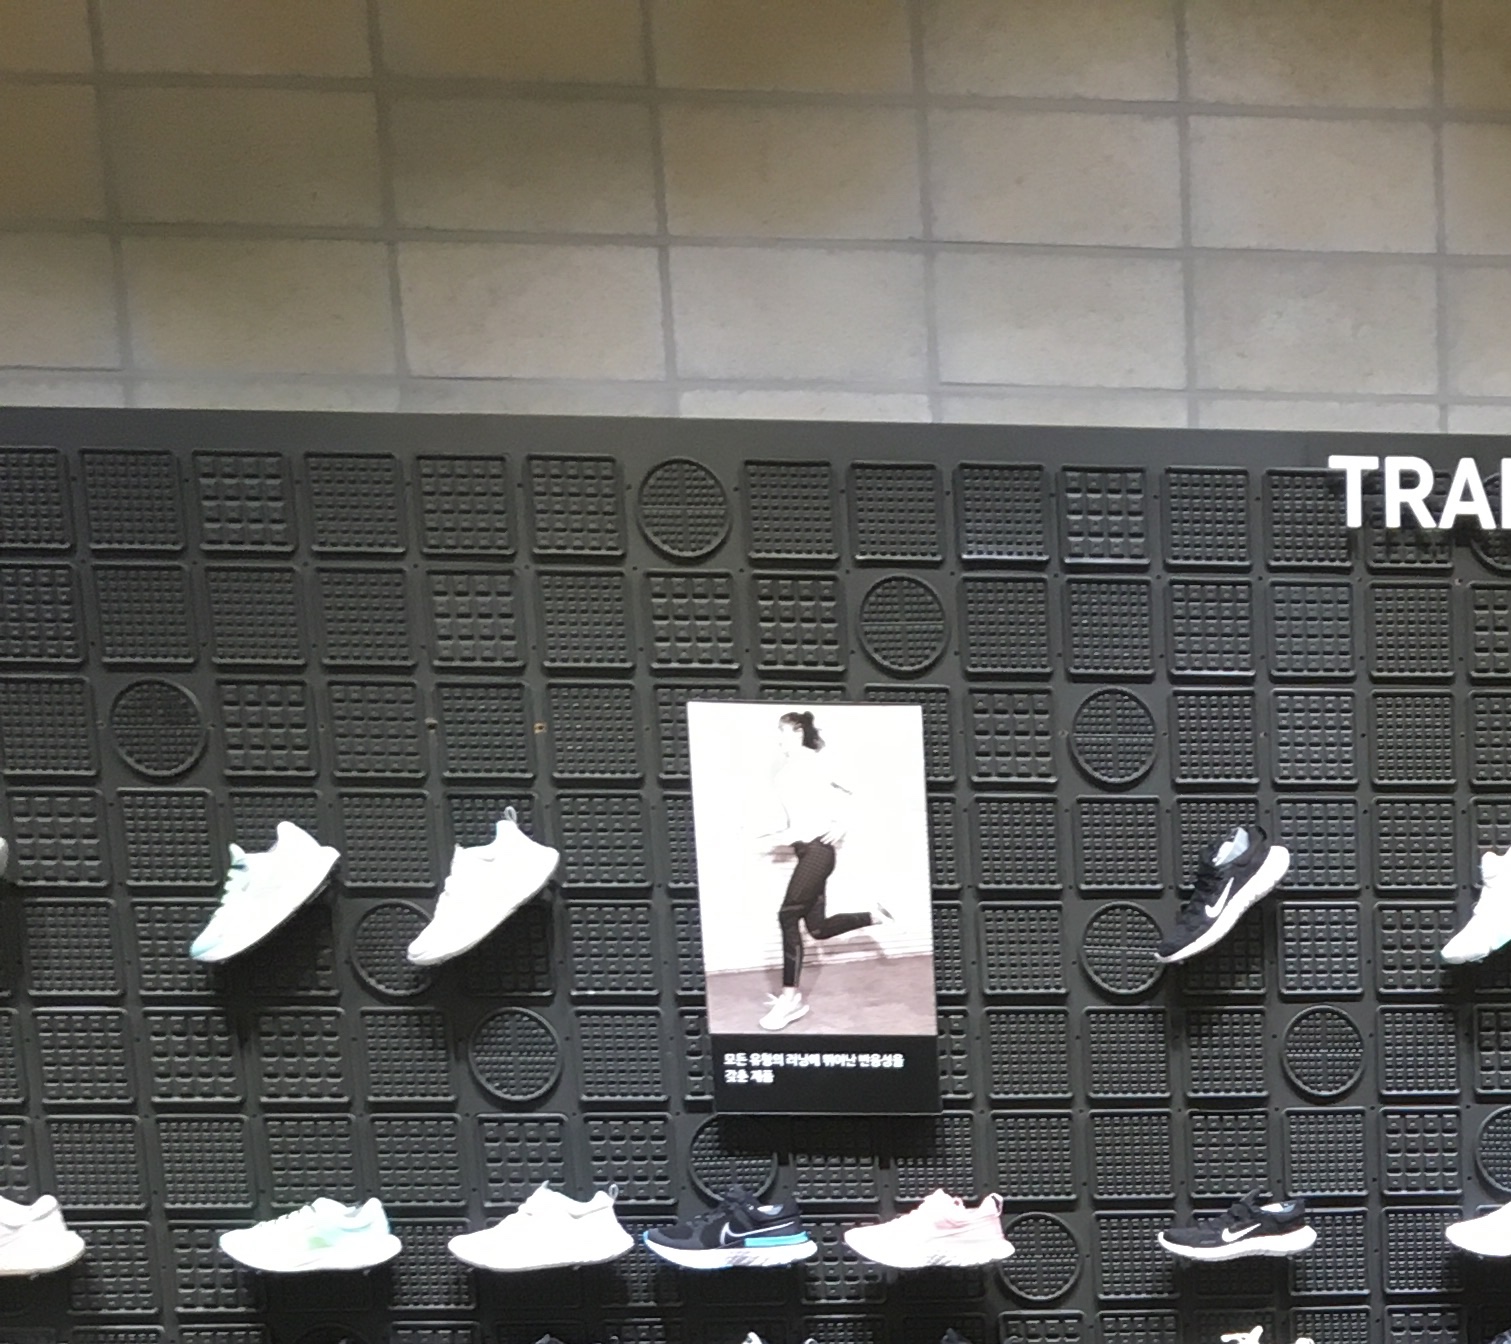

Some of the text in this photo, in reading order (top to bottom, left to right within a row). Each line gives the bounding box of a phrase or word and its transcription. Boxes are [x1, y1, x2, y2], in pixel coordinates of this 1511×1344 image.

[723, 1052, 905, 1068] 모든 유형의 러닝에 뛰어난 반응성을
[749, 1069, 775, 1084] 제품
